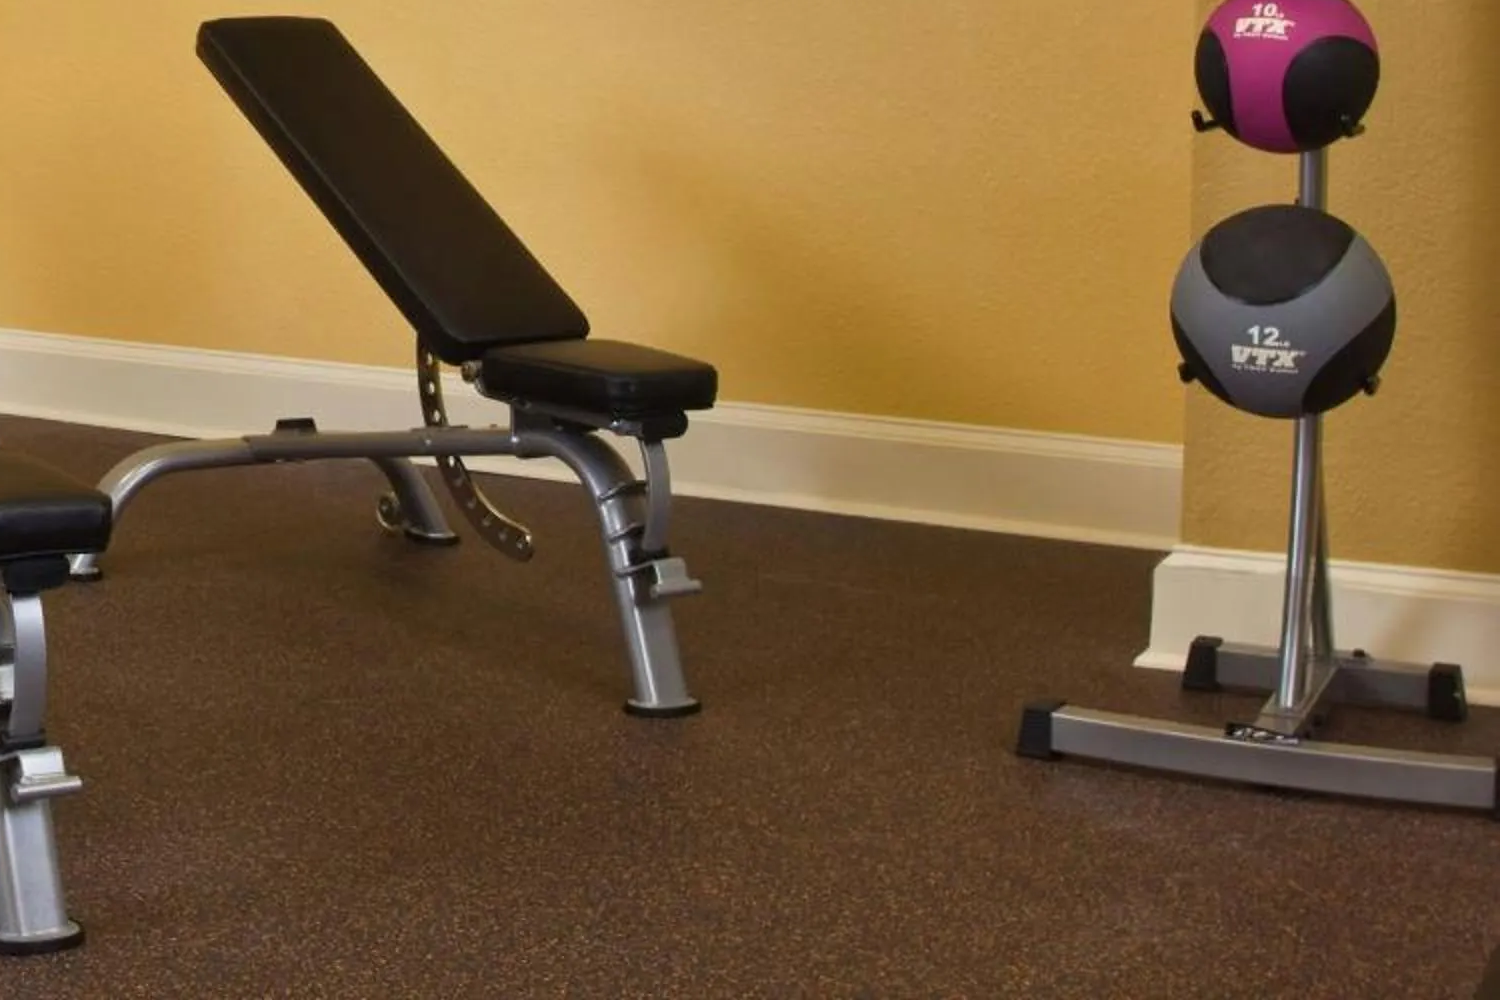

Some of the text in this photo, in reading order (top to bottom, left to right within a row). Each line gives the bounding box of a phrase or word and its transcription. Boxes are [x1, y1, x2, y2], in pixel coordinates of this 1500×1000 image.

[1252, 2, 1277, 17] 10
[1235, 17, 1296, 35] VTX
[1247, 324, 1280, 346] 12
[1231, 344, 1306, 368] VTX
